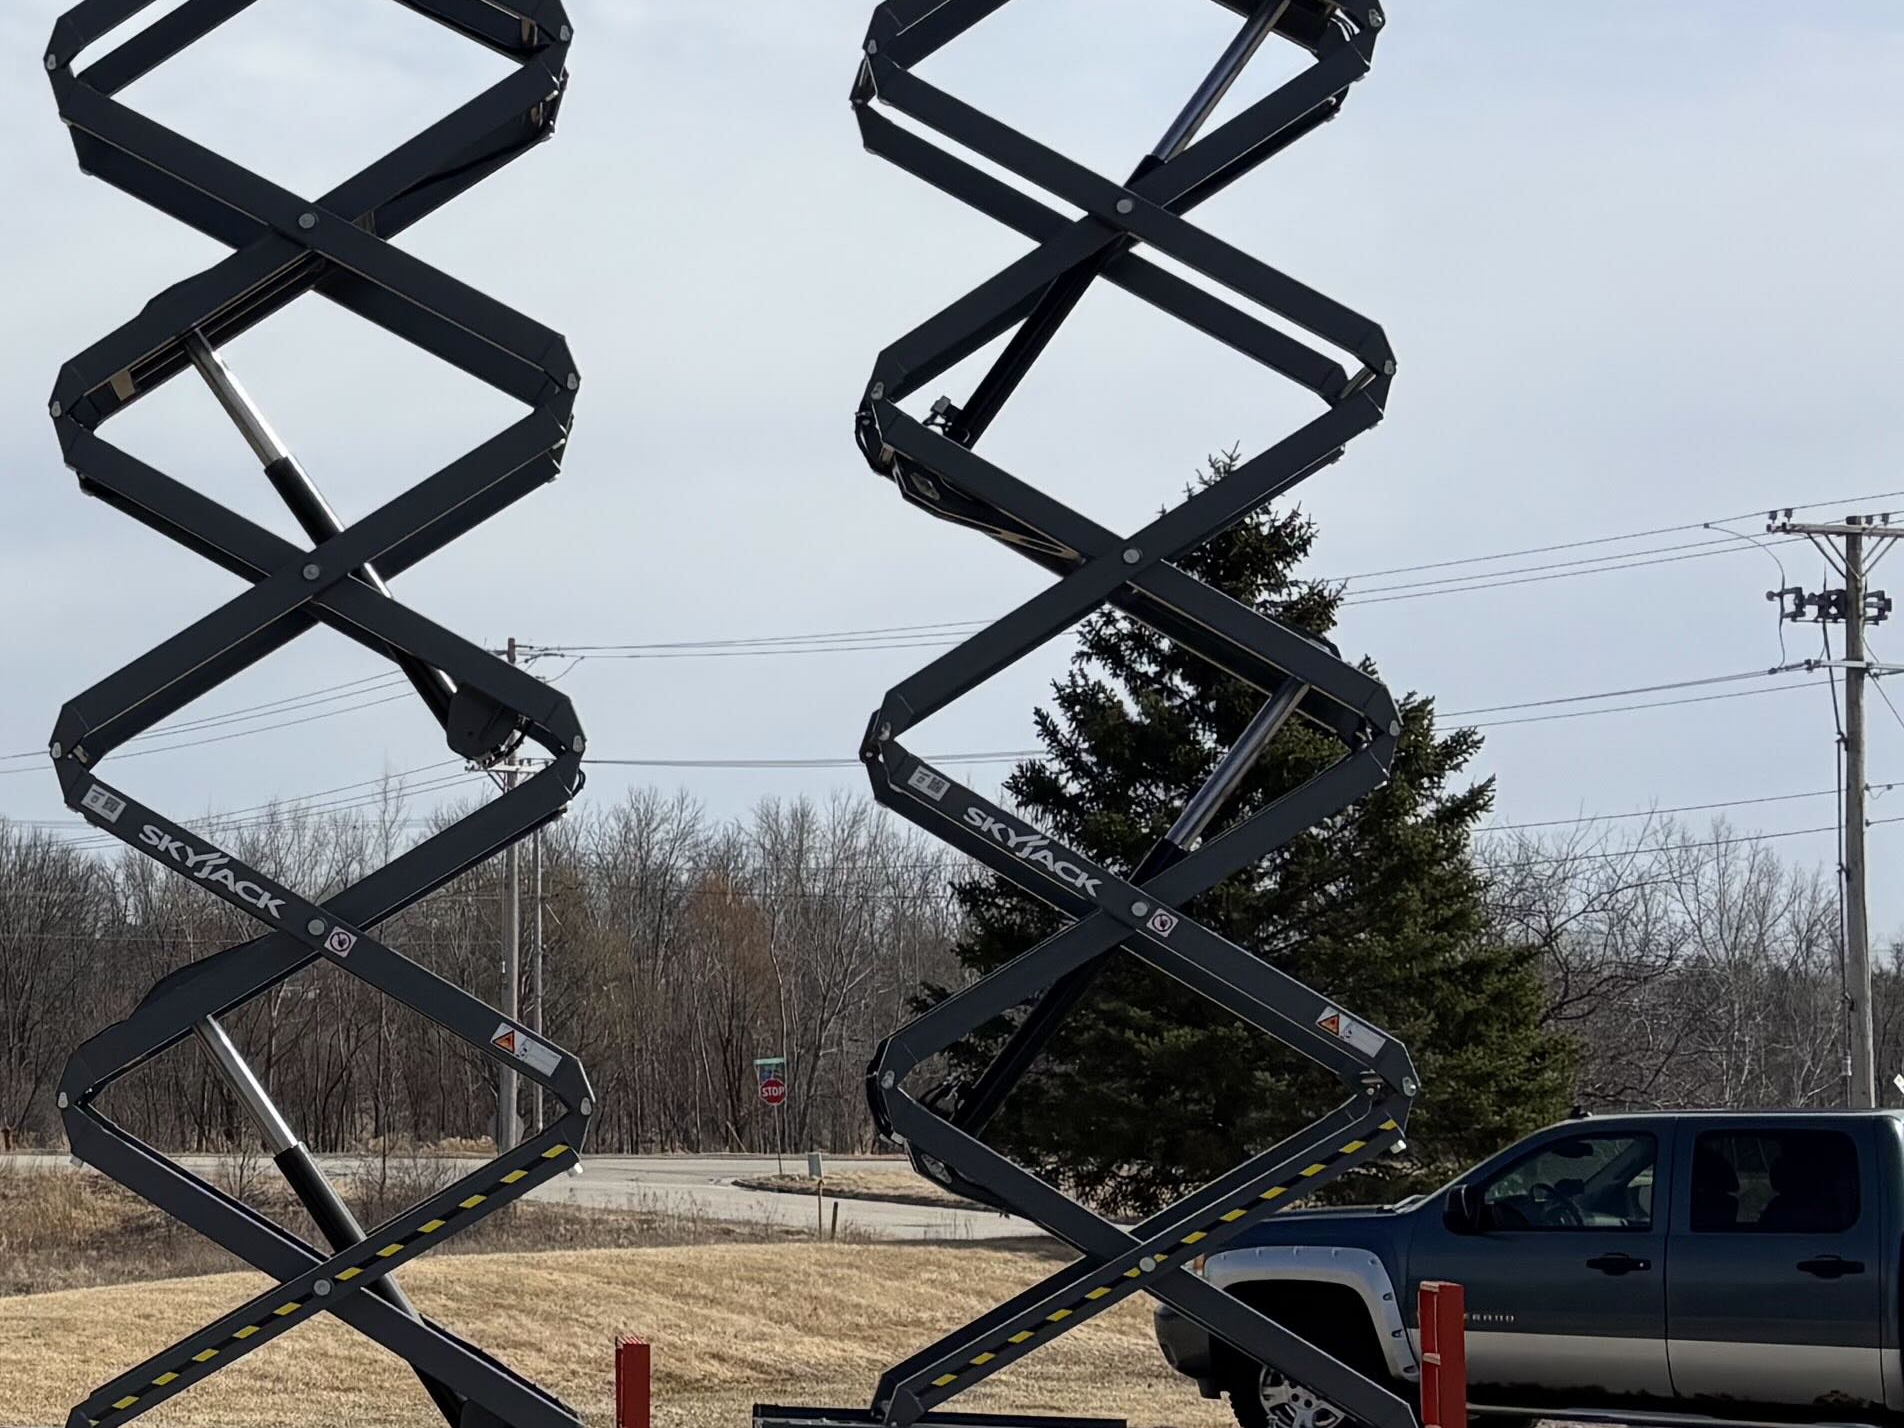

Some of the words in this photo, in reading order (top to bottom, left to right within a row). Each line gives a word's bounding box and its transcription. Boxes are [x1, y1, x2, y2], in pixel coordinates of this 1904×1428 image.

[138, 824, 286, 919] SKYJACK
[963, 806, 1103, 898] SKYJACK
[762, 1086, 785, 1097] STOP
